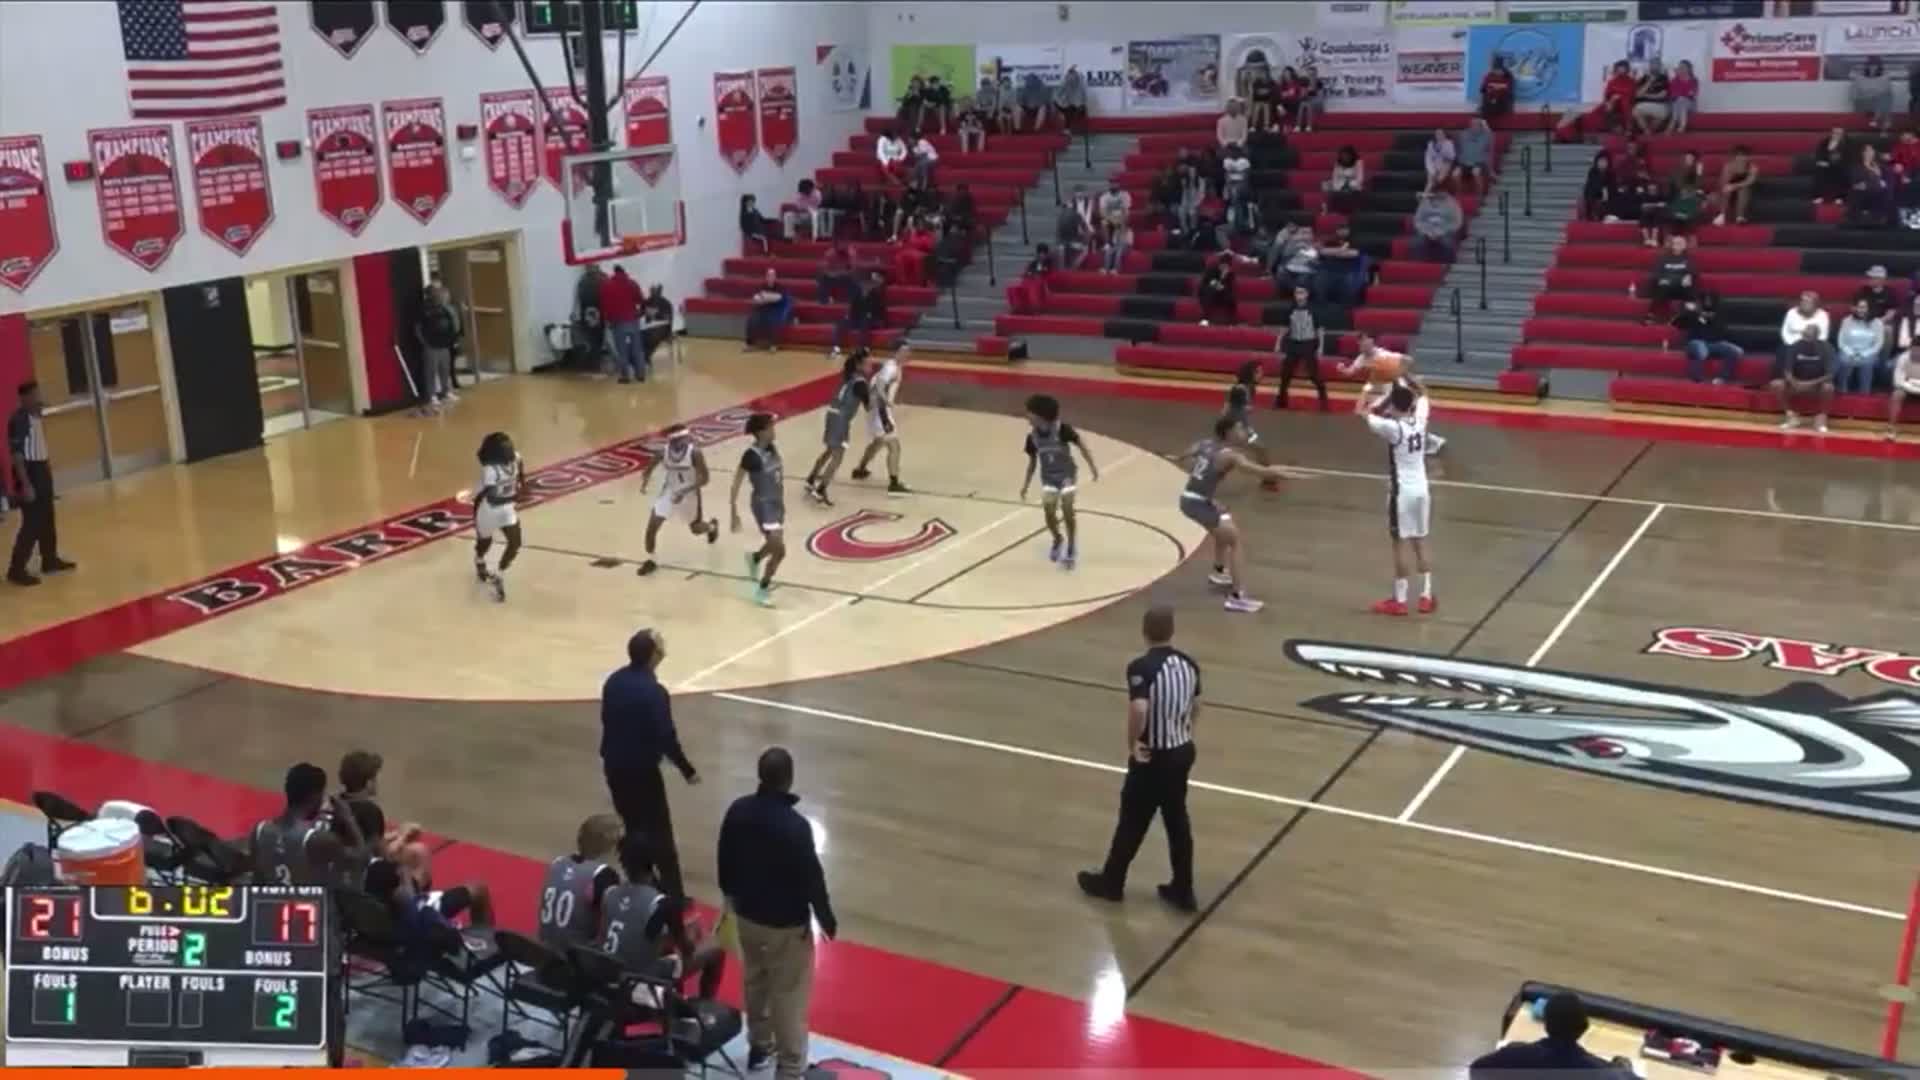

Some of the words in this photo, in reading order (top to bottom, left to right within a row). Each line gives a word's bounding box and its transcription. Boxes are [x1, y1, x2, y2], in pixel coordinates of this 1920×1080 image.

[1087, 70, 1123, 82] LUX
[1400, 62, 1461, 74] WEAVER
[95, 136, 171, 175] CHAMPIONS
[191, 127, 262, 166] CHAMPIONS
[541, 887, 576, 929] 30
[602, 919, 625, 955] 5
